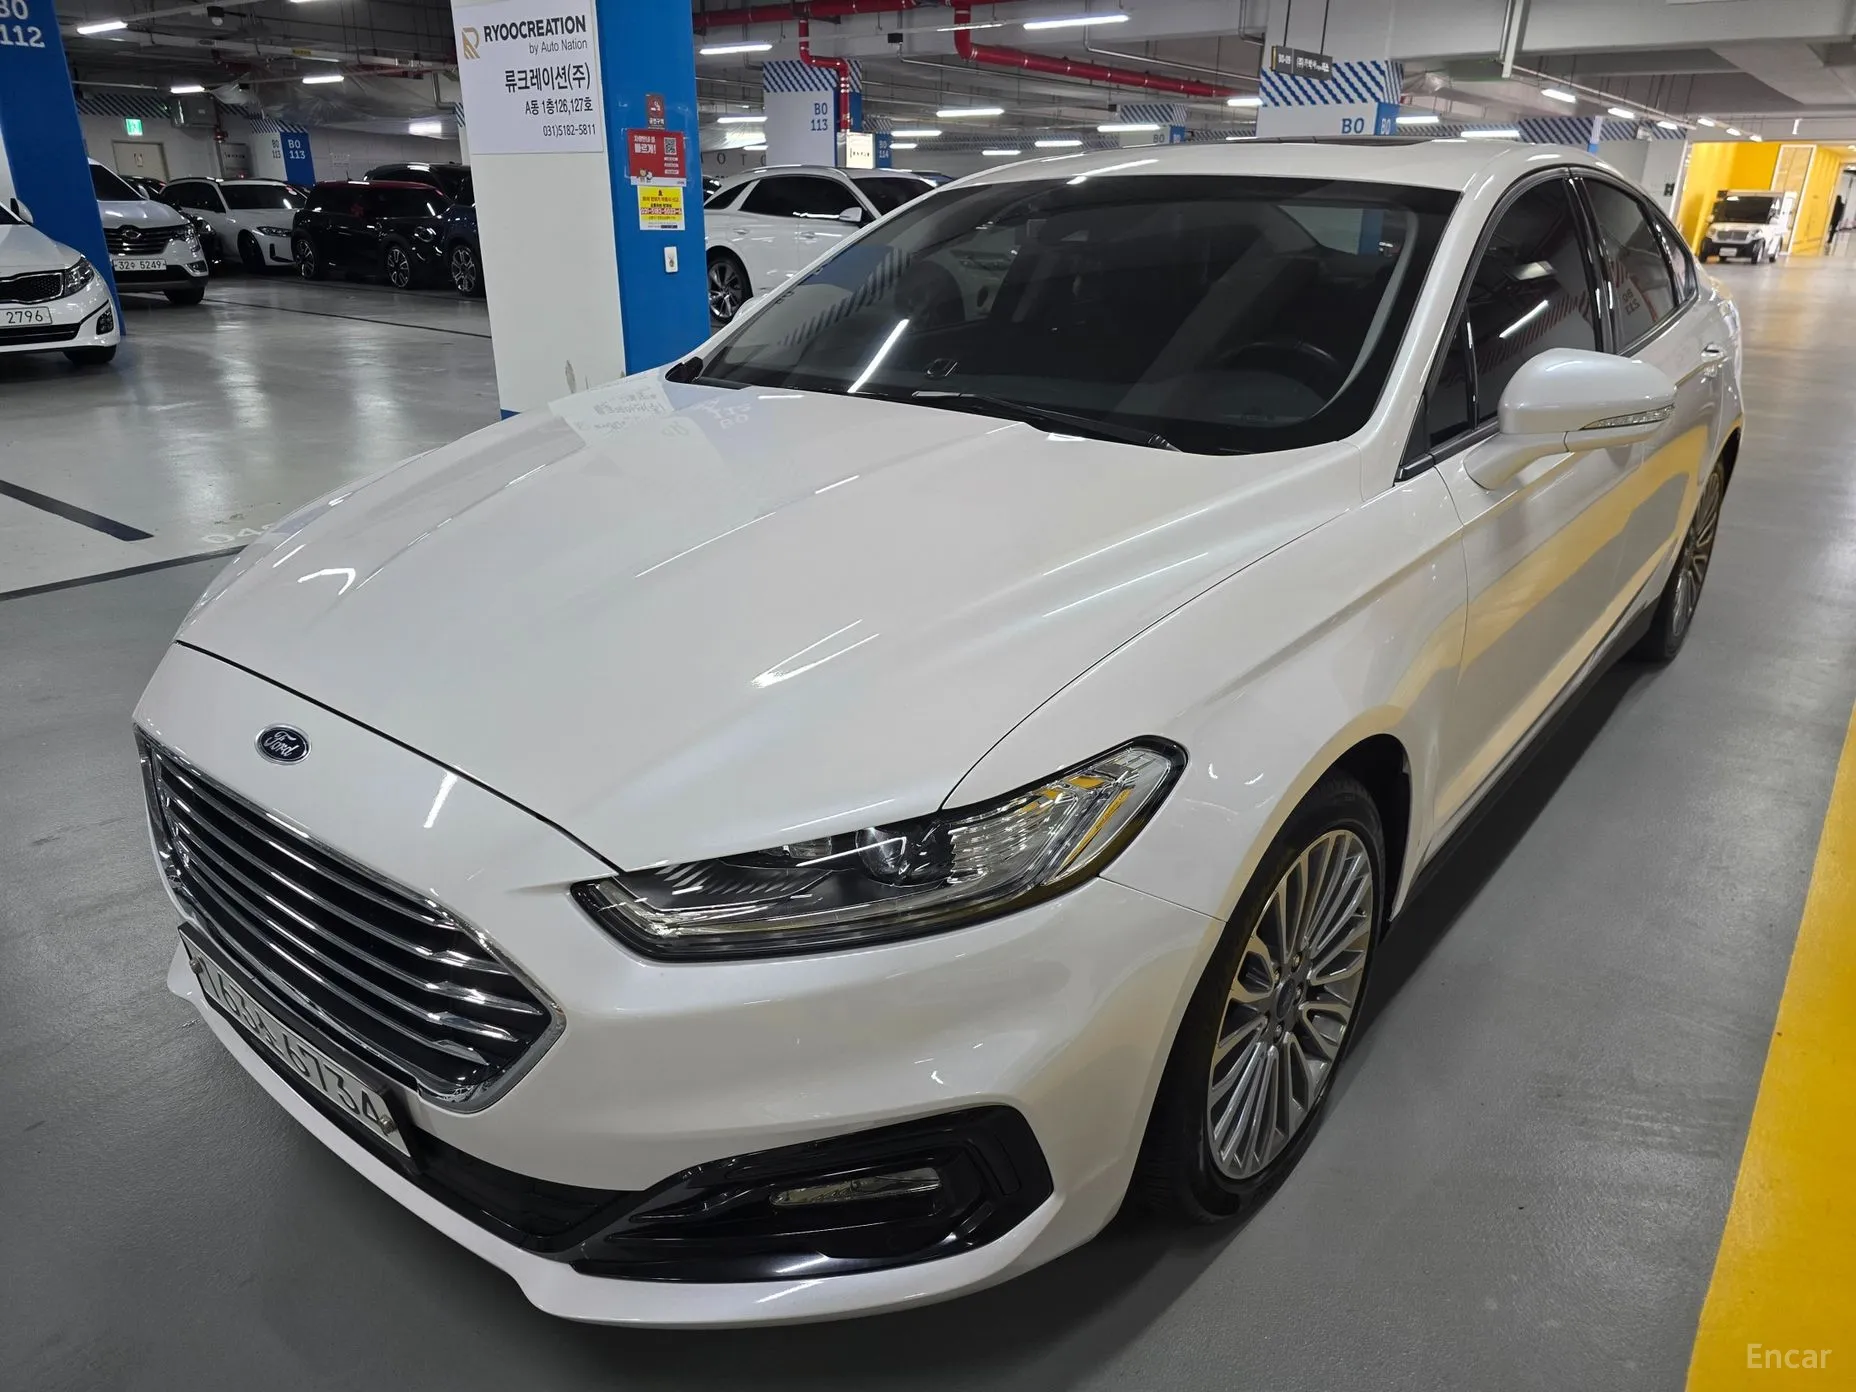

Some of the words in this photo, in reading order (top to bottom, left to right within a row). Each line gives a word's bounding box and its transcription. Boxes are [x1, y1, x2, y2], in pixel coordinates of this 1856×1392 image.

[0, 24, 46, 48] 112
[483, 15, 587, 42] RYOOCREATION
[529, 42, 539, 55] by
[541, 41, 559, 53] Auto
[561, 39, 588, 51] Nation
[505, 62, 591, 93] 류크레이션(주)
[525, 100, 540, 115] A동
[542, 123, 596, 138] 031)5182-5811
[810, 118, 829, 131] 113
[289, 149, 306, 160] 113
[139, 261, 162, 270] 5249
[6, 310, 43, 324] 2796
[263, 731, 299, 756] Ford
[282, 1032, 391, 1136] 6734
